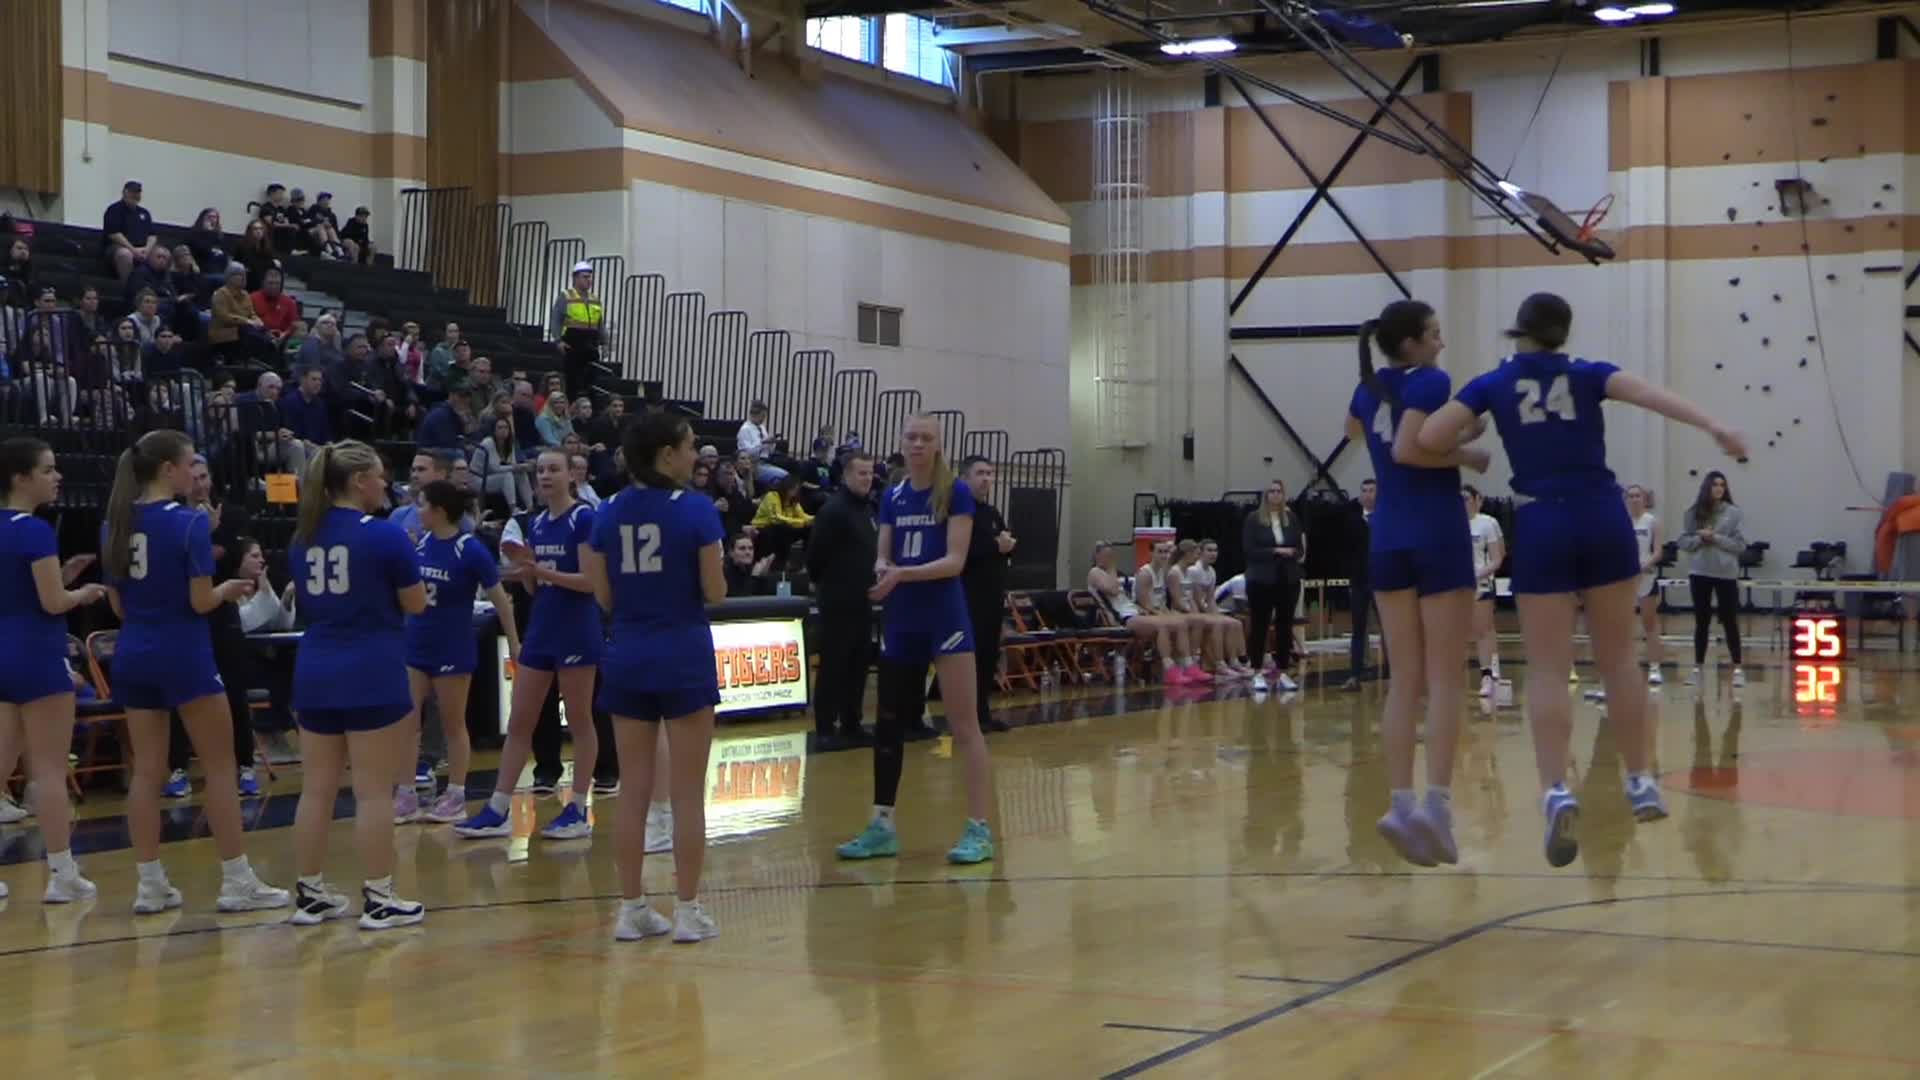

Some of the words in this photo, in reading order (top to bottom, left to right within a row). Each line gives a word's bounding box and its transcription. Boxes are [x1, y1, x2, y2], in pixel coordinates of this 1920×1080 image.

[1515, 374, 1577, 424] 24
[129, 532, 148, 580] 3
[305, 545, 350, 596] 33
[619, 523, 663, 574] 12
[1795, 618, 1840, 657] 35
[715, 641, 800, 690] TIGERS
